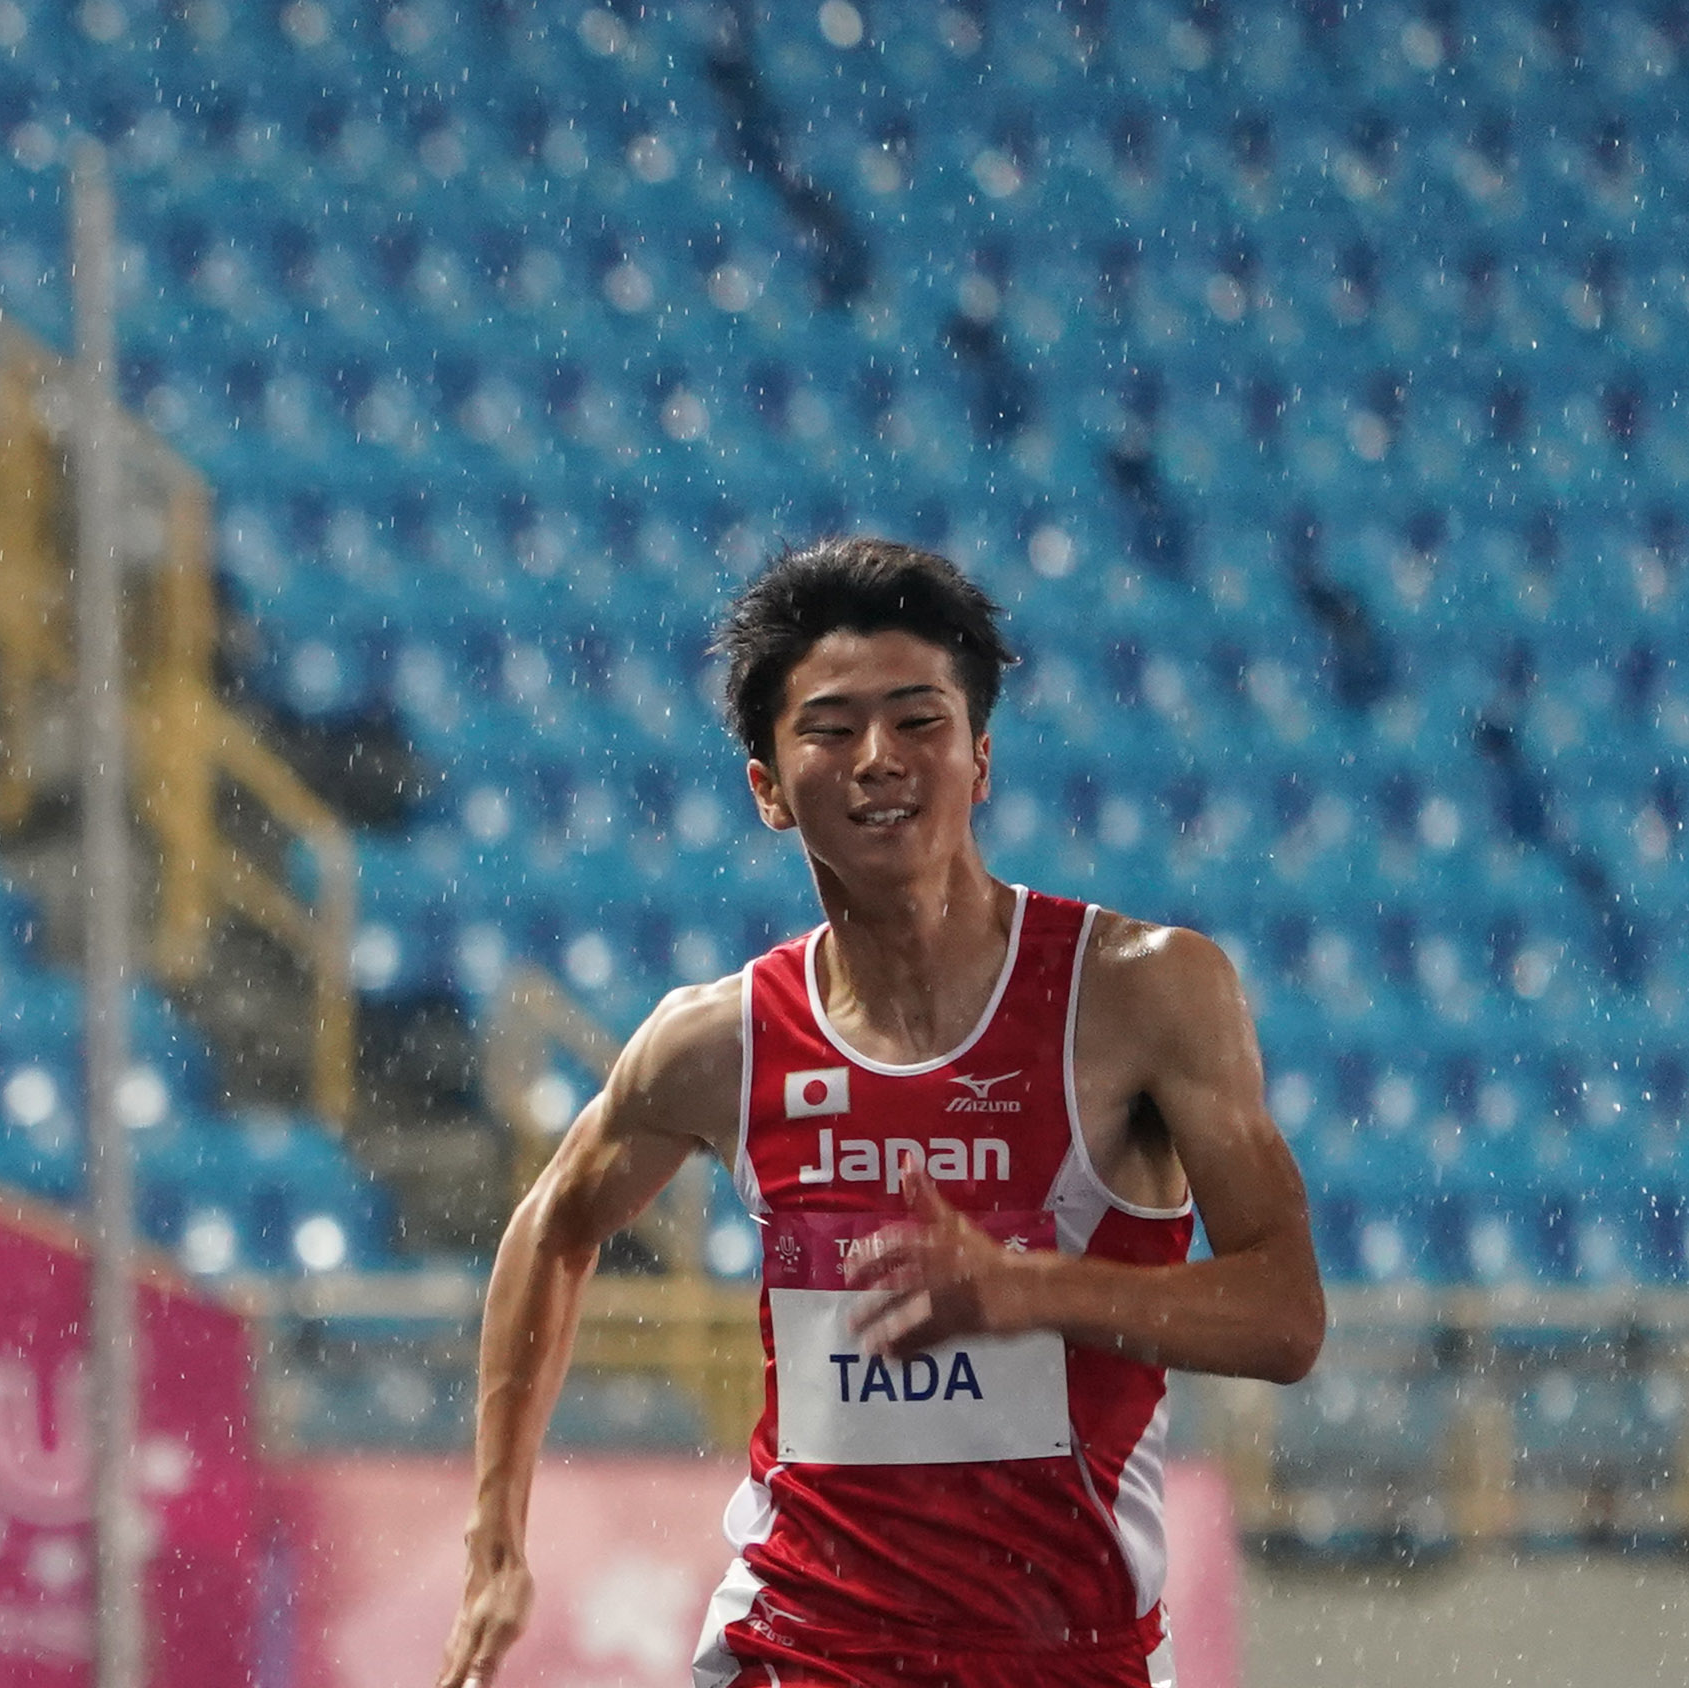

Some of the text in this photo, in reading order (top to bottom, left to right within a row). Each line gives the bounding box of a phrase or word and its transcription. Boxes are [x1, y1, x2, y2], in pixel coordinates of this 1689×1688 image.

[945, 1097, 1021, 1113] MIZUNO
[799, 1128, 1010, 1194] Japan
[834, 1237, 886, 1258] TAIP
[830, 1352, 984, 1402] TADA
